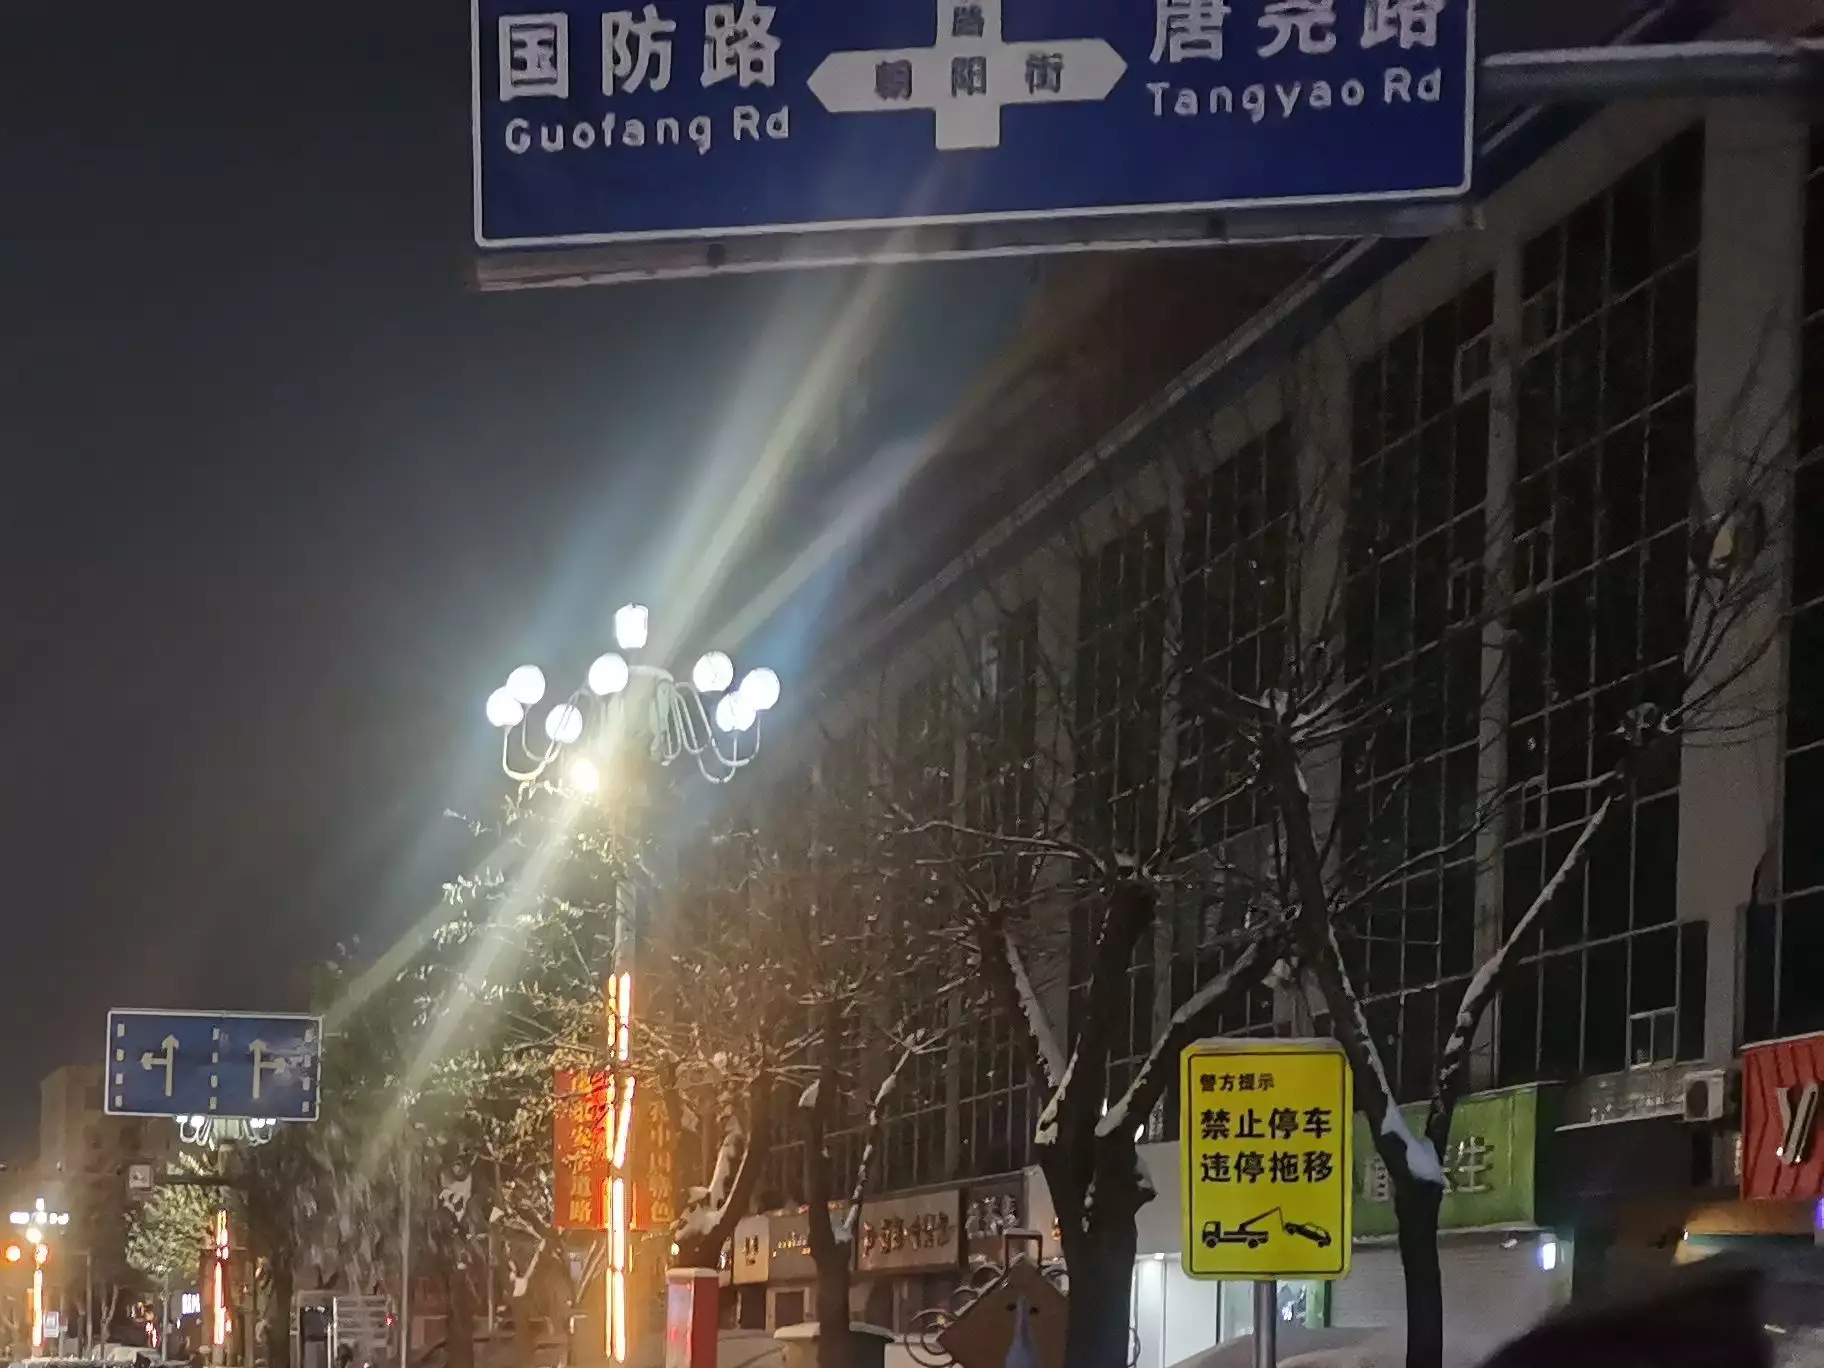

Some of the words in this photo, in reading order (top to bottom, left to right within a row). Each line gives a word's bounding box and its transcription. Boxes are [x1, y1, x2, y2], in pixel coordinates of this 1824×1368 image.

[498, 0, 782, 101] 国防路
[1146, 80, 1365, 125] Tangyao
[1383, 66, 1442, 105] Rd
[504, 112, 712, 156] Guofang
[732, 104, 790, 141] Rd
[1199, 1072, 1275, 1093] 警方提示
[1200, 1107, 1333, 1141] 禁止停车
[1200, 1150, 1334, 1185] 违停拖移
